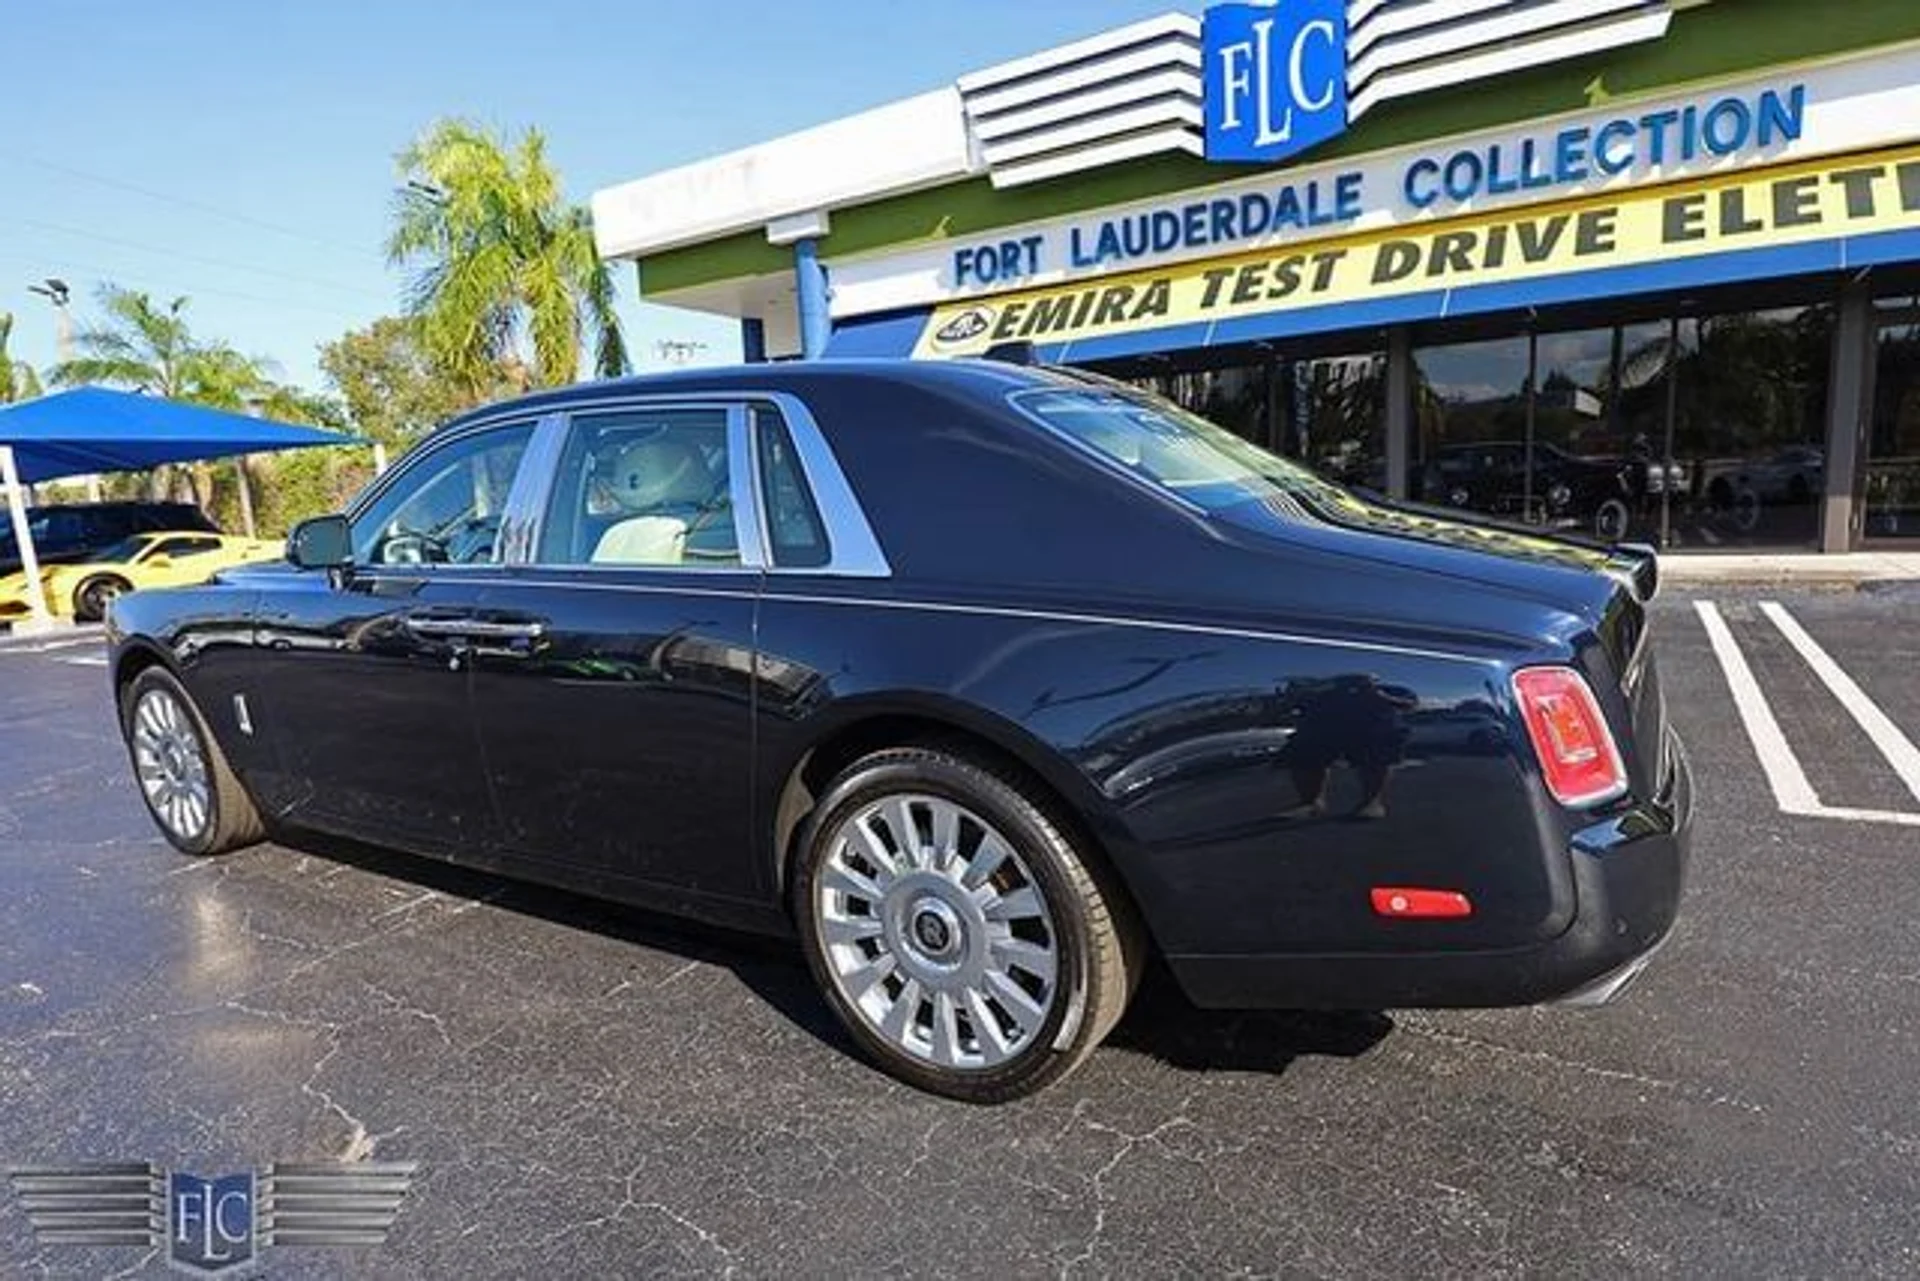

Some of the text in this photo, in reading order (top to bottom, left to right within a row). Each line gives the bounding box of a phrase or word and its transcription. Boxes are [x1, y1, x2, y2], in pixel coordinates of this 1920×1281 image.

[1219, 18, 1335, 148] FLC
[954, 84, 1806, 287] FORT LAUDERDALE COLLECTION
[989, 279, 1170, 341] EMIRA
[1201, 250, 1346, 308] TEST
[1371, 207, 1619, 285] DRIVE
